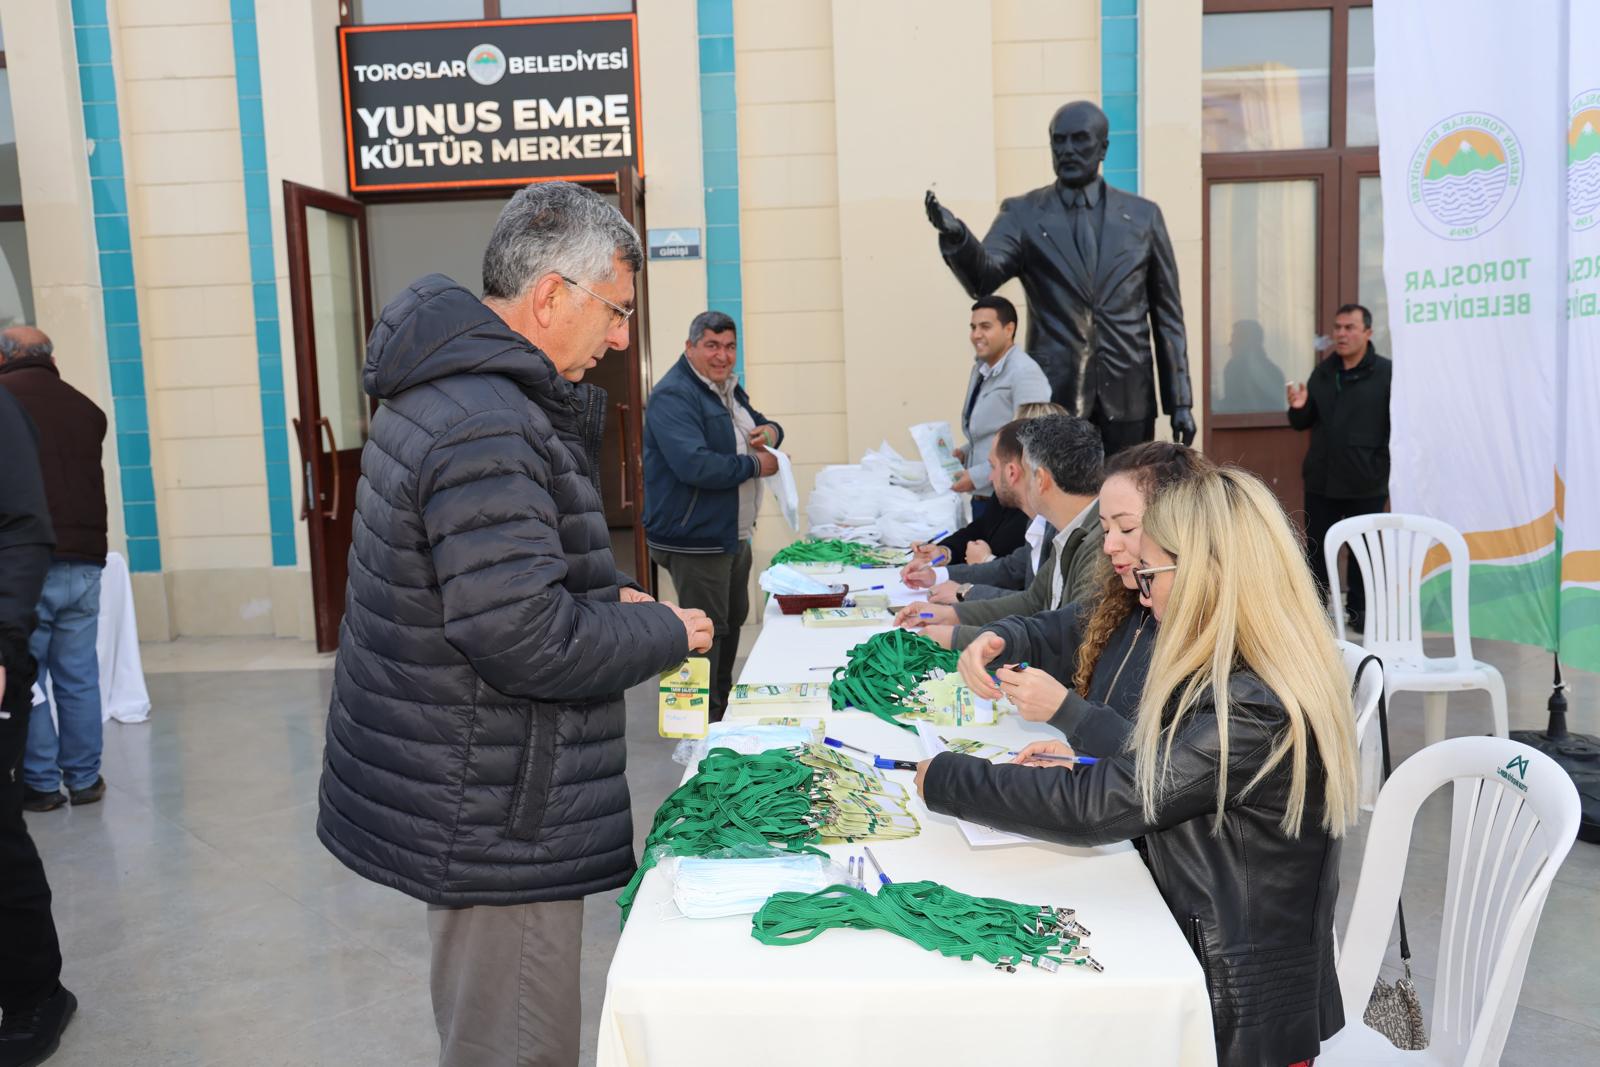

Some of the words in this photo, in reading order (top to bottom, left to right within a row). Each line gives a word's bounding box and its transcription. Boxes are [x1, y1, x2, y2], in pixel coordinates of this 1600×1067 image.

[354, 60, 466, 82] TOROSLAR
[509, 47, 628, 74] BELEDİYESİ
[357, 101, 502, 138] YUNUS
[513, 94, 631, 130] EMRE
[360, 135, 484, 169] KÜLTÜR
[492, 126, 632, 162] MERKEZİ
